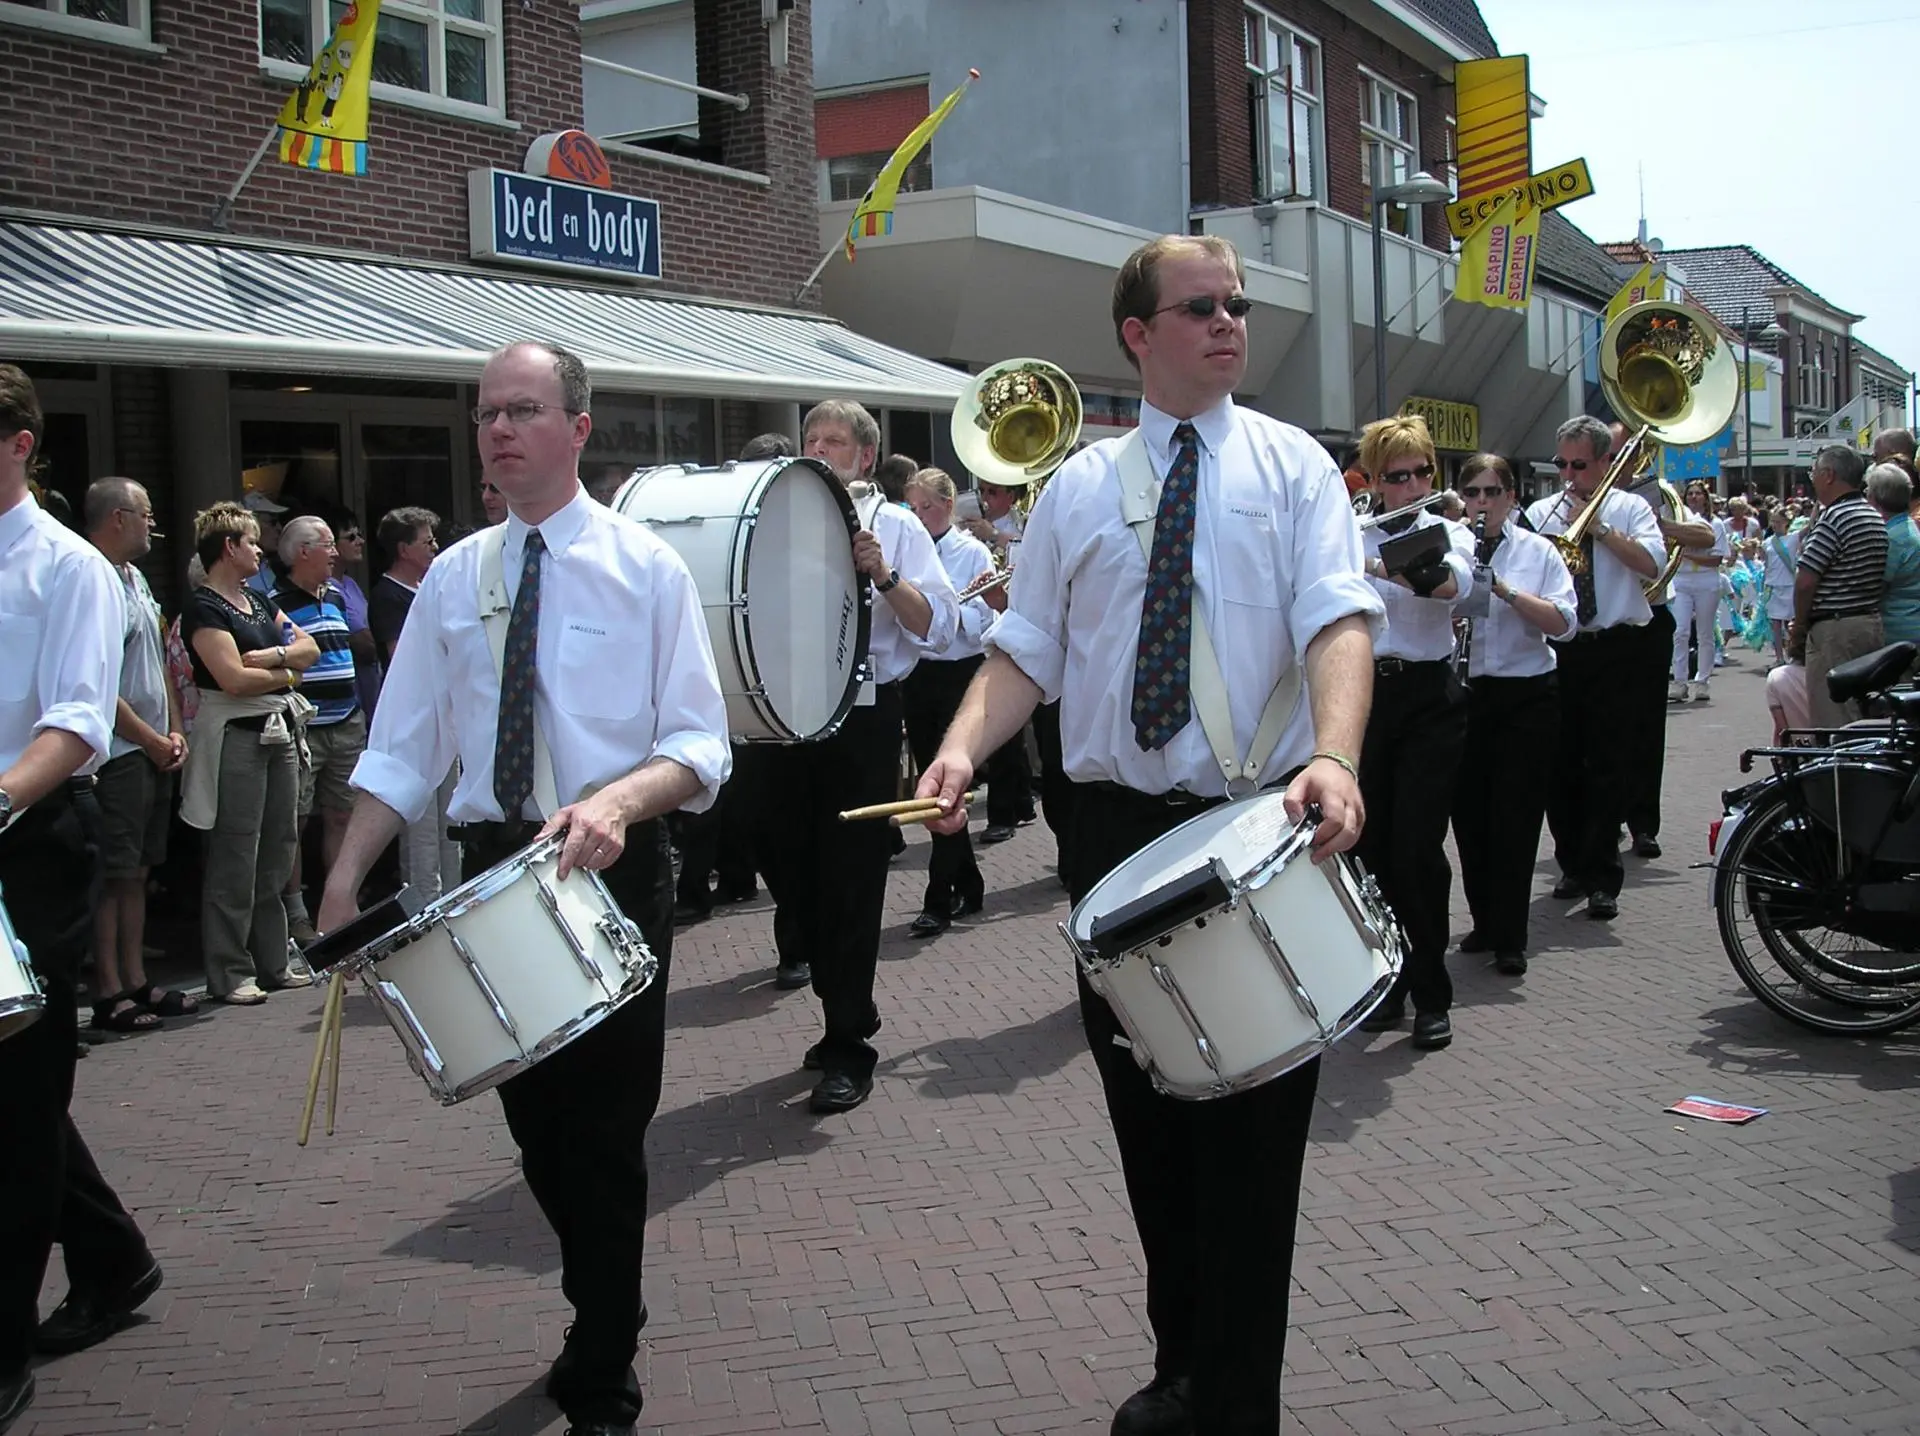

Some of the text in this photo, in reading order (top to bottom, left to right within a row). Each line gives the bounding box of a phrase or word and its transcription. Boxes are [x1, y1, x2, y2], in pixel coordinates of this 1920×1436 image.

[503, 176, 648, 273] bed en body
[1484, 226, 1505, 295] SCAPINO
[1507, 235, 1527, 301] SCAPINO
